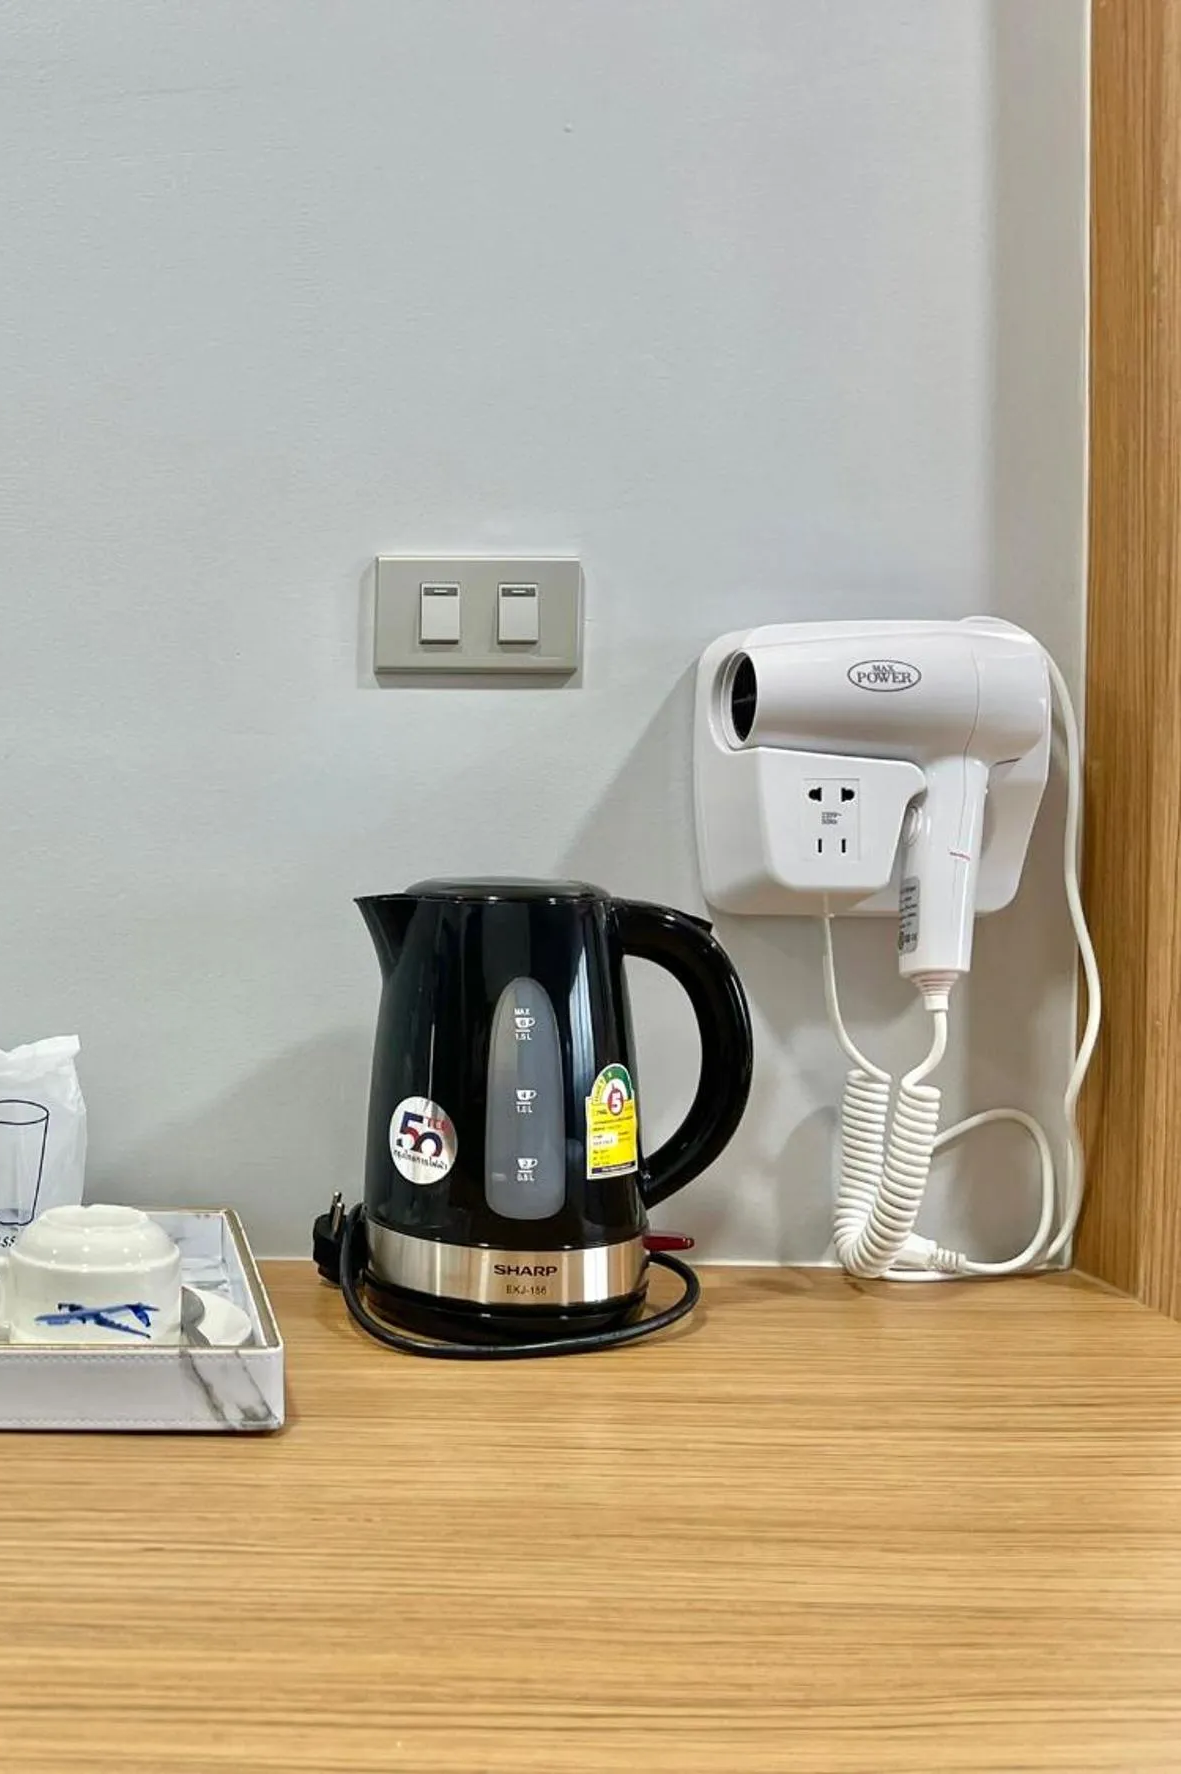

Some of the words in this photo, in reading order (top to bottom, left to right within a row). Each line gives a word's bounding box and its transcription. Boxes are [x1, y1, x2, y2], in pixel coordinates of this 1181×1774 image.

[872, 665, 895, 673] MAX
[857, 672, 911, 683] POWER
[494, 1264, 558, 1277] SHARP
